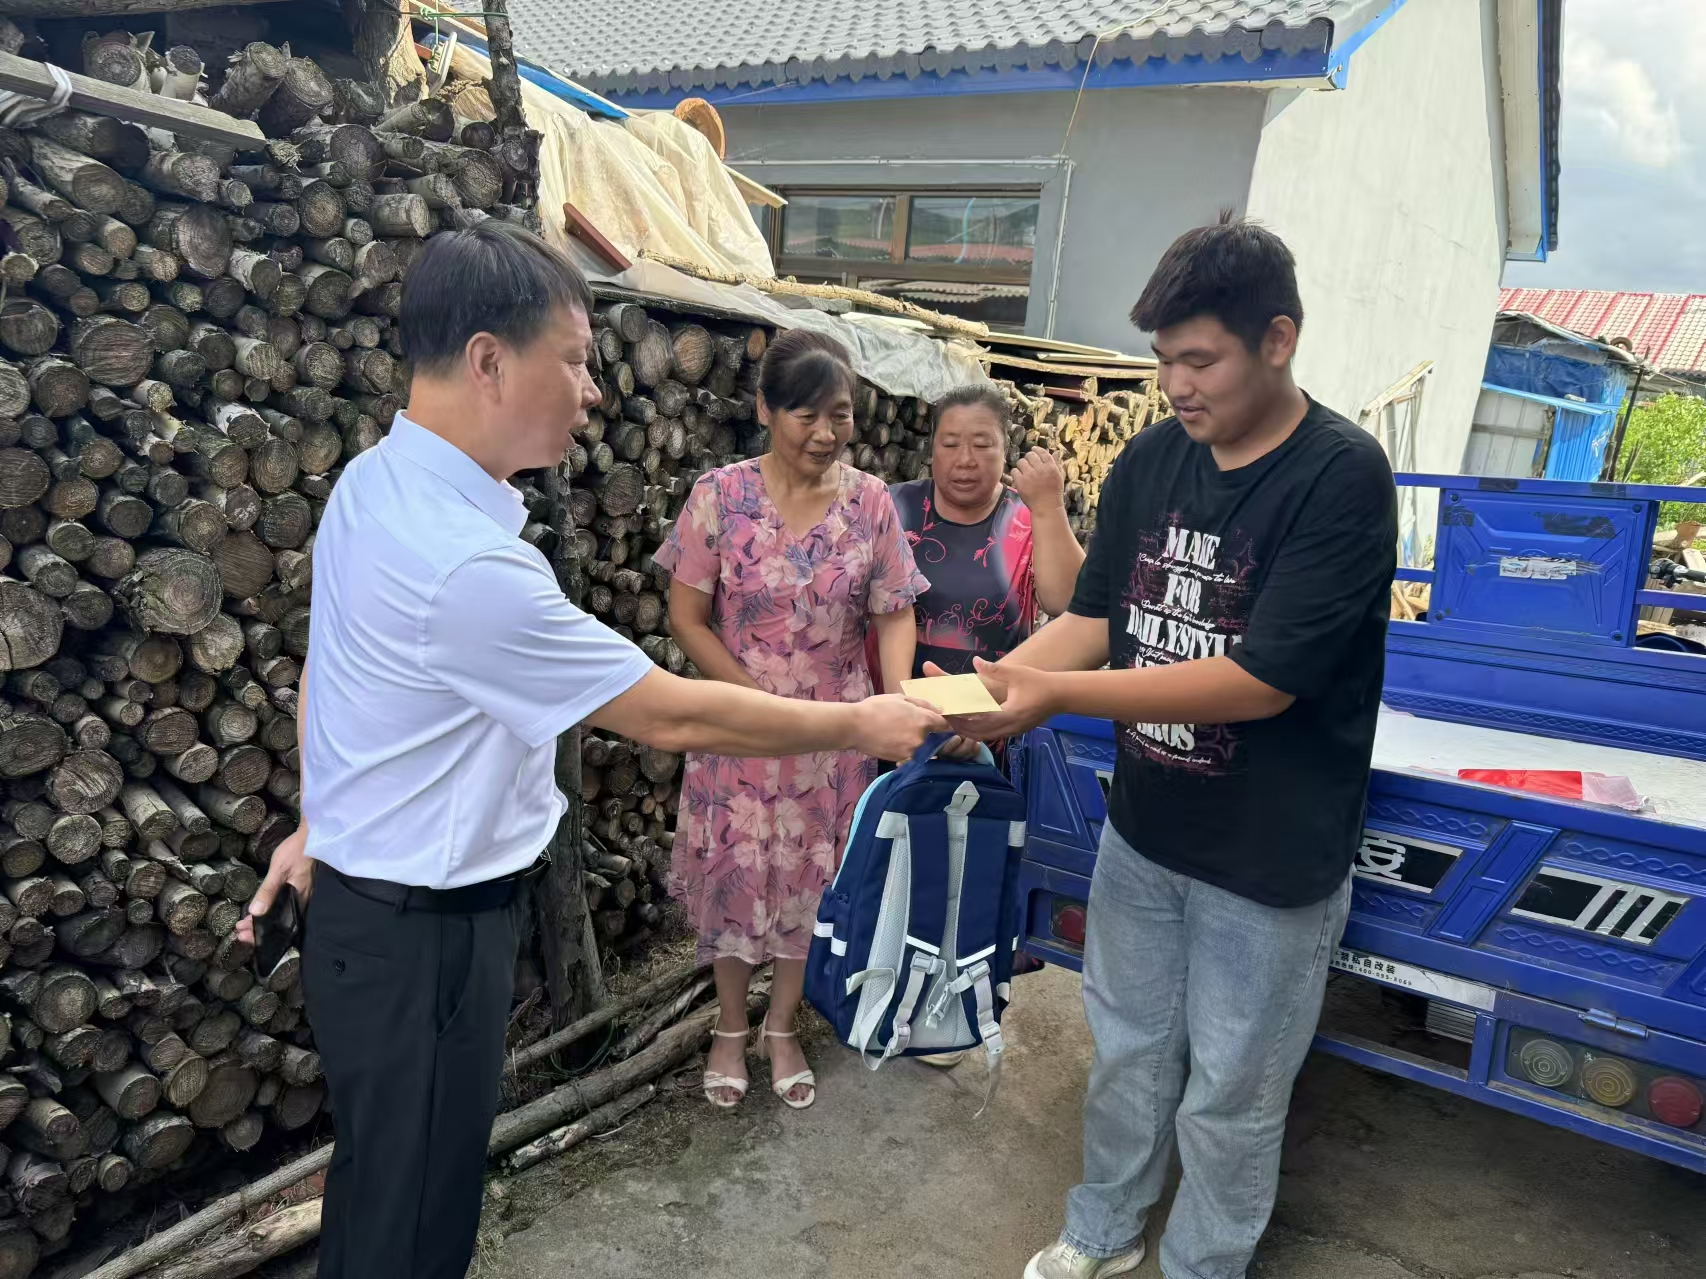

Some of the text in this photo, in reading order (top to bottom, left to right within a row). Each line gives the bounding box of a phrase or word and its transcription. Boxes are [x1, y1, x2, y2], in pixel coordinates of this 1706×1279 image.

[1164, 573, 1202, 615] FOR
[1126, 603, 1242, 661] DAILYSTYL
[1336, 950, 1396, 975] 禁私自改装
